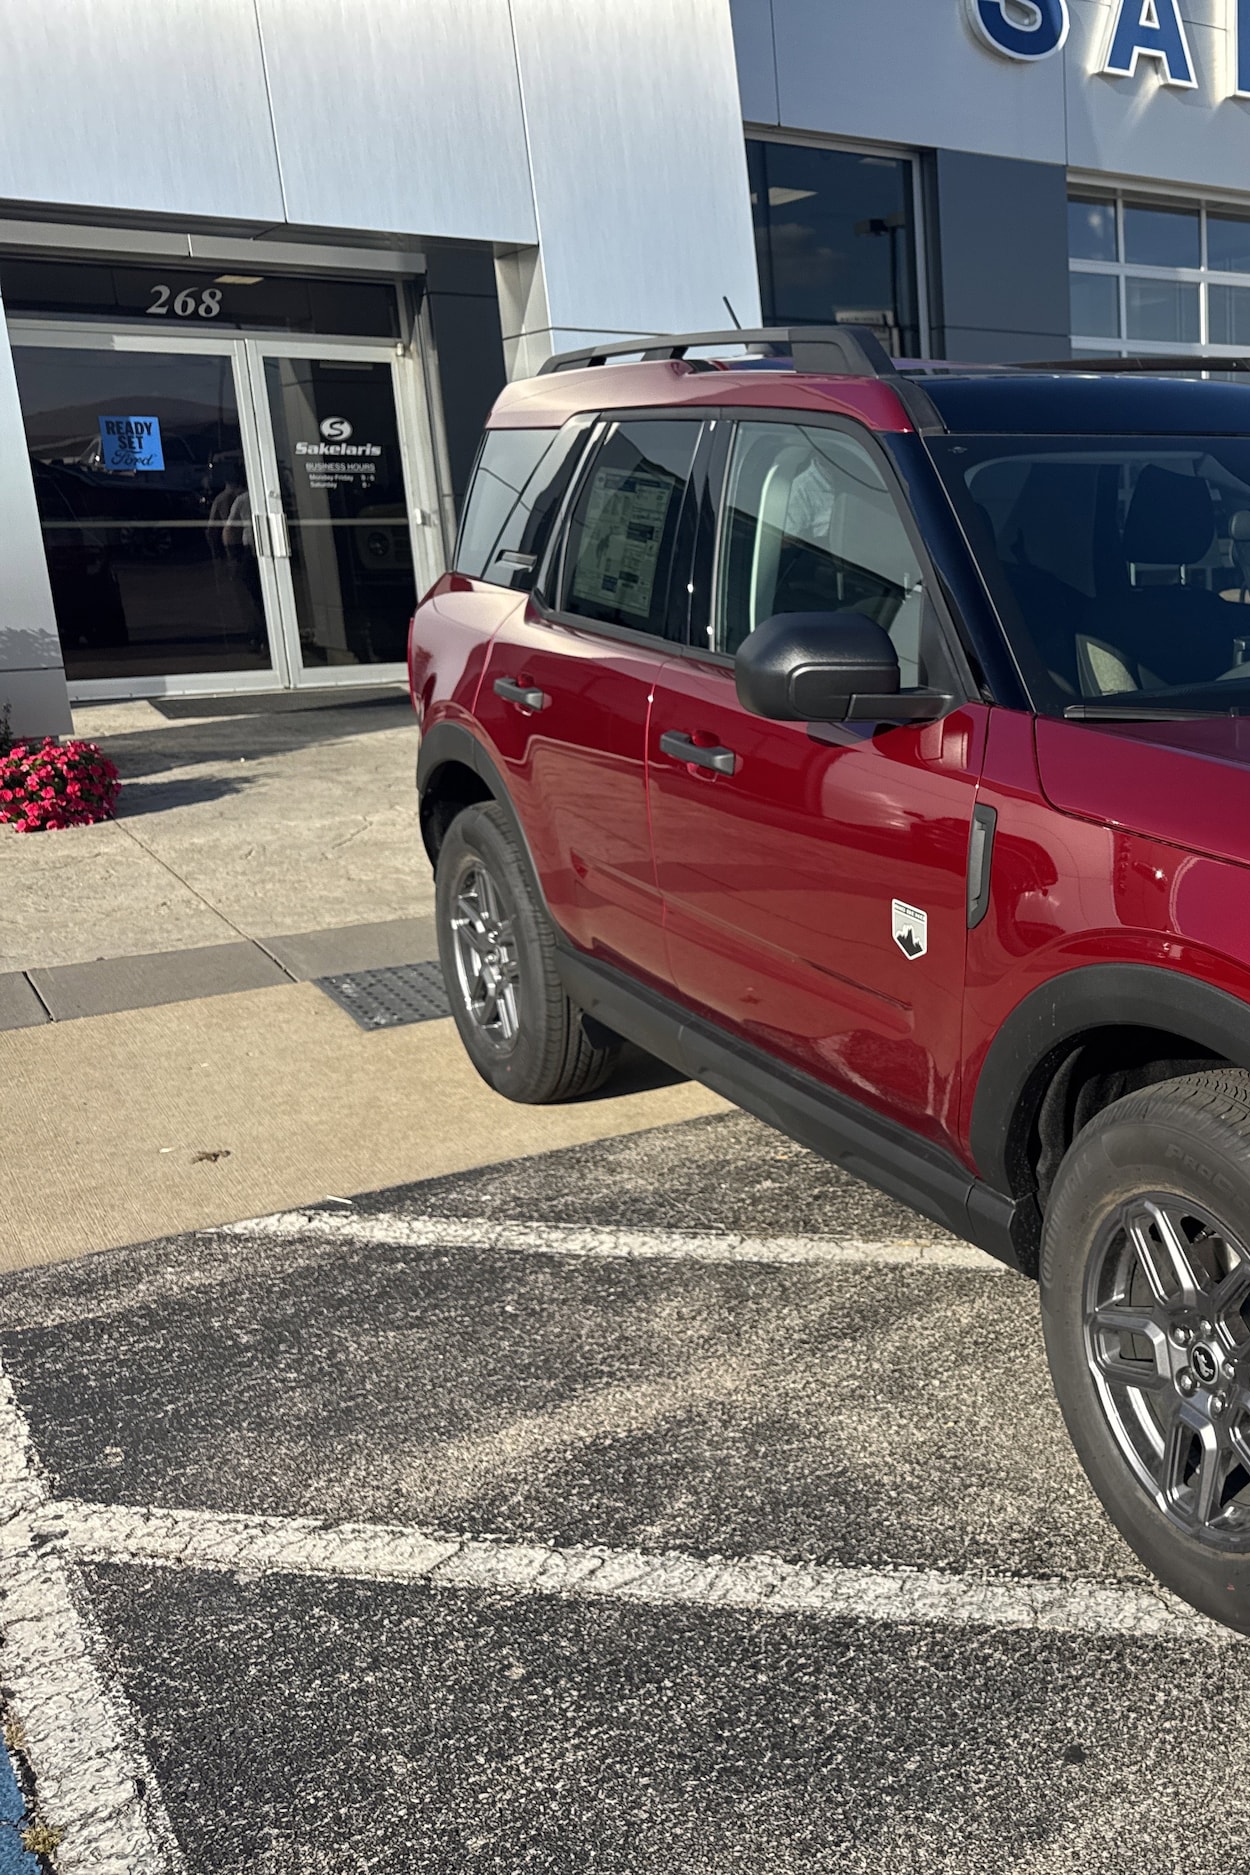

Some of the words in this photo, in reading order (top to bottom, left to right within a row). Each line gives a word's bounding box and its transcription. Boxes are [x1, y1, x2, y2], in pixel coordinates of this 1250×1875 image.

[145, 285, 222, 318] 268
[105, 421, 152, 436] READY
[118, 436, 143, 449] SET
[295, 442, 381, 456] Sakelaris
[111, 450, 154, 466] Ford
[347, 463, 376, 473] HOURS
